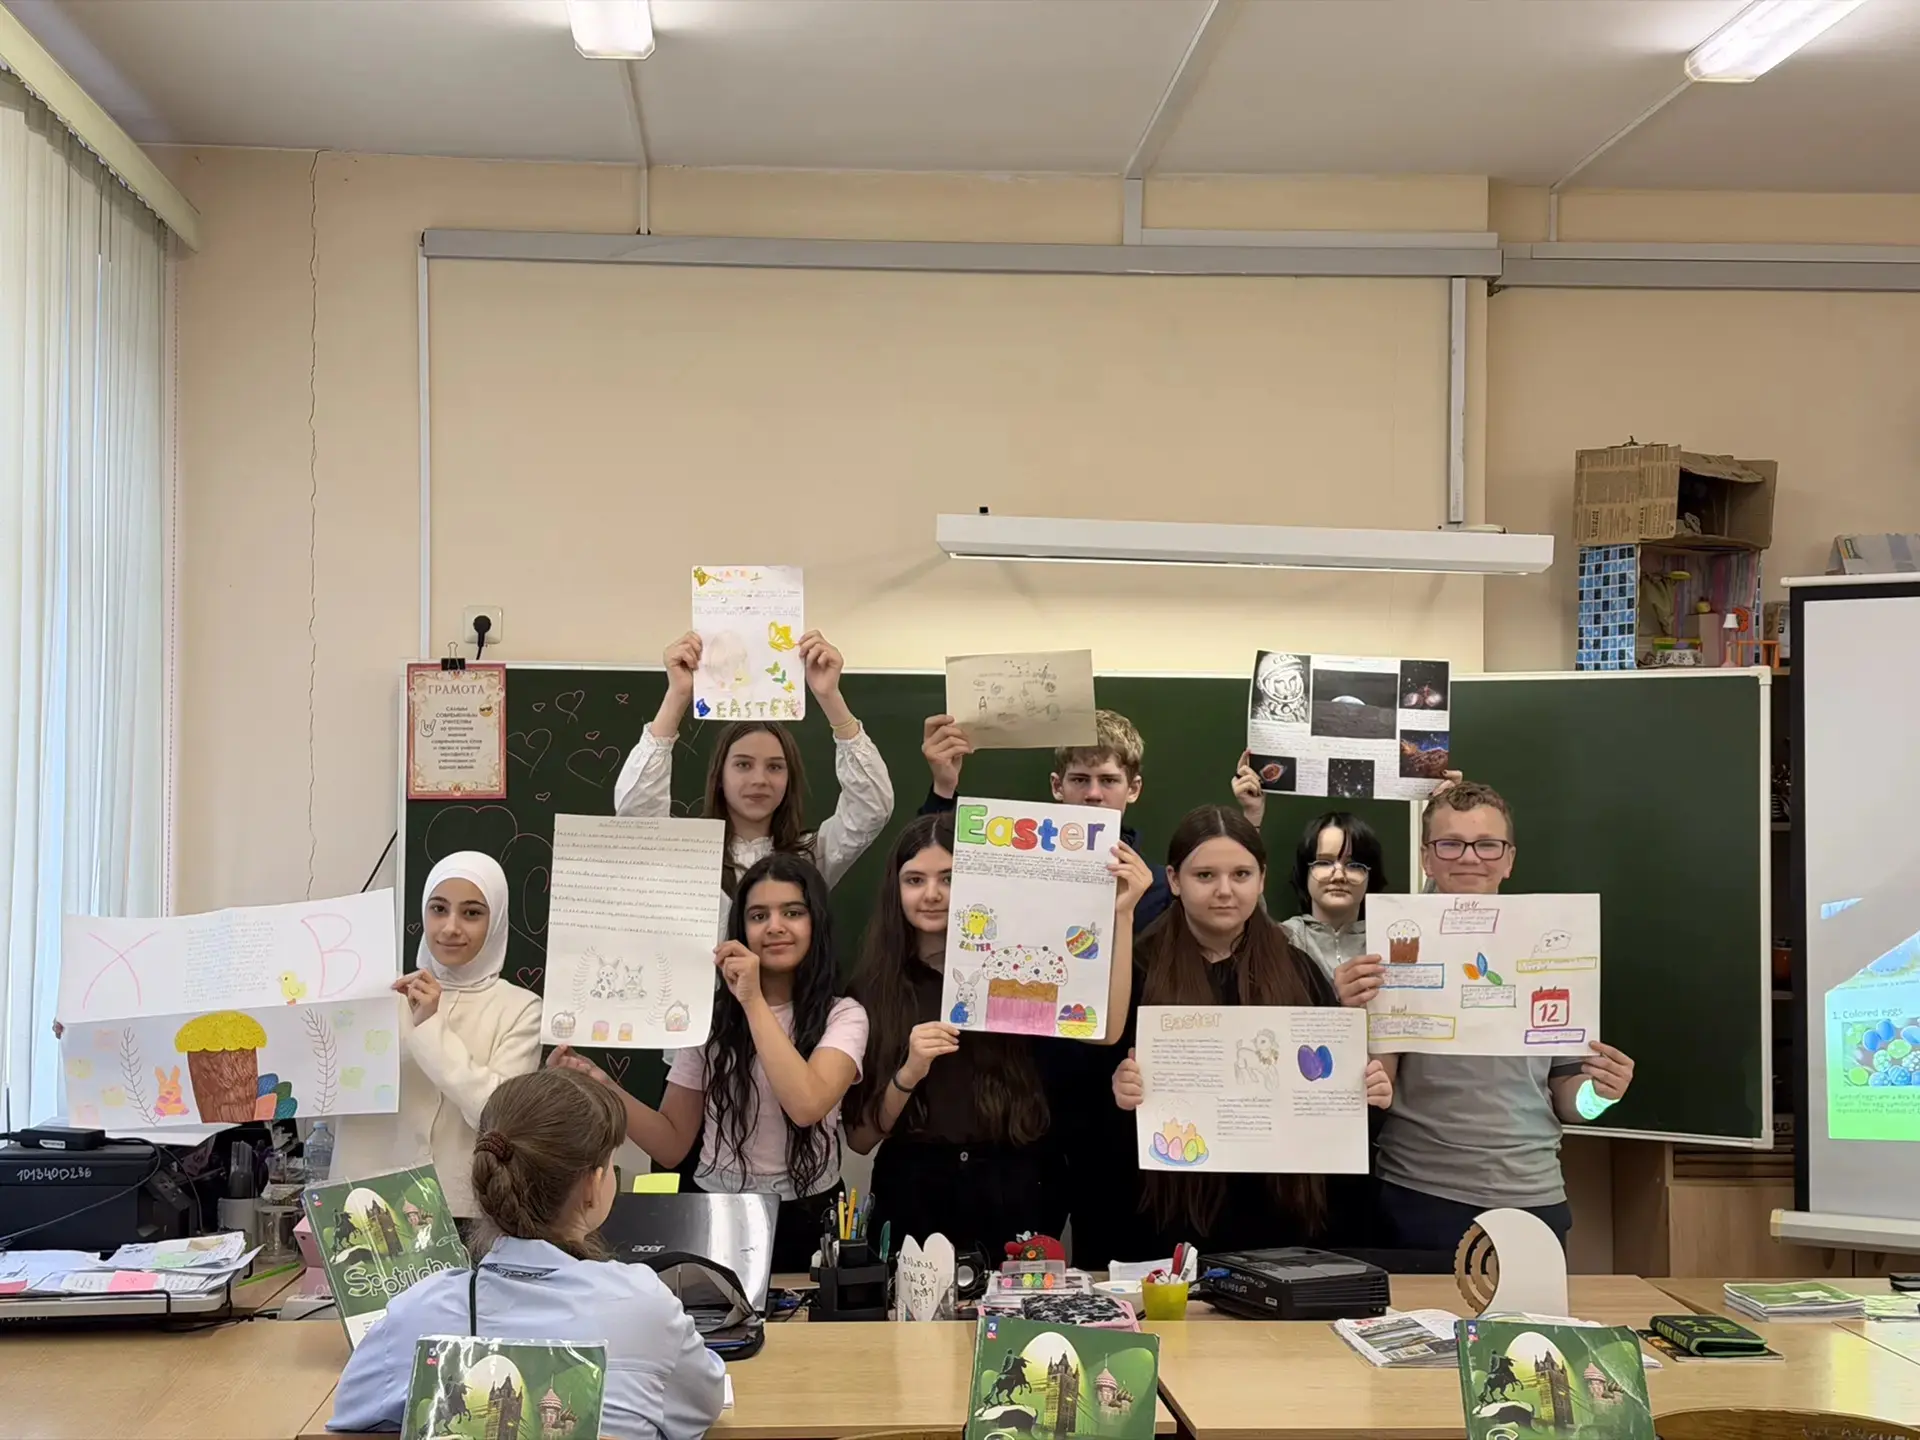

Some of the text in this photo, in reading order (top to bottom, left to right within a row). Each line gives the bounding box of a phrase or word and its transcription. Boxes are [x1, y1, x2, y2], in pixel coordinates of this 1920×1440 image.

[428, 684, 485, 695] ГРАМОТА
[957, 804, 1105, 852] Easter
[1539, 1003, 1560, 1023] 12
[1832, 1007, 1904, 1020] 1. Colored eggs
[1160, 1012, 1222, 1032] Easter
[631, 1244, 666, 1253] acer
